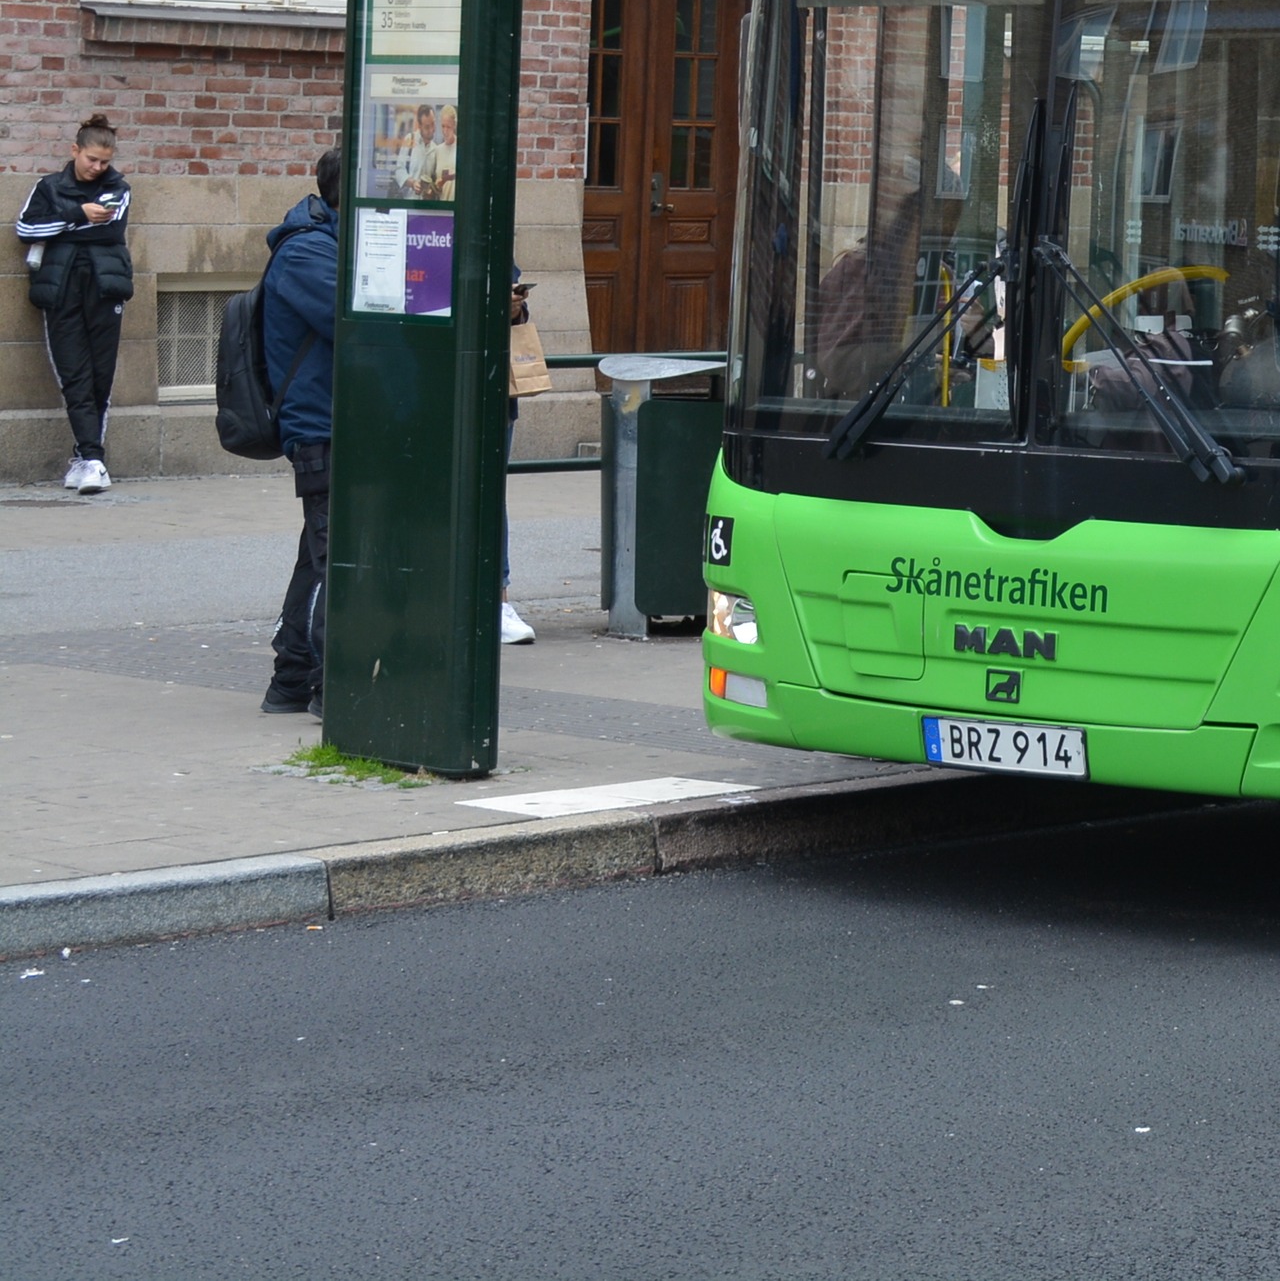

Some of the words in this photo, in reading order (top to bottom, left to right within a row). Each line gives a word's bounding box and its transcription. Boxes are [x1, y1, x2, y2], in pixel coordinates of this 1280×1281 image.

[381, 11, 393, 28] 35
[406, 231, 452, 249] mycket
[885, 556, 1109, 614] Skånetrafiken
[953, 622, 1059, 661] MAN
[949, 724, 1002, 762] BRZ
[1012, 730, 1073, 769] 914
